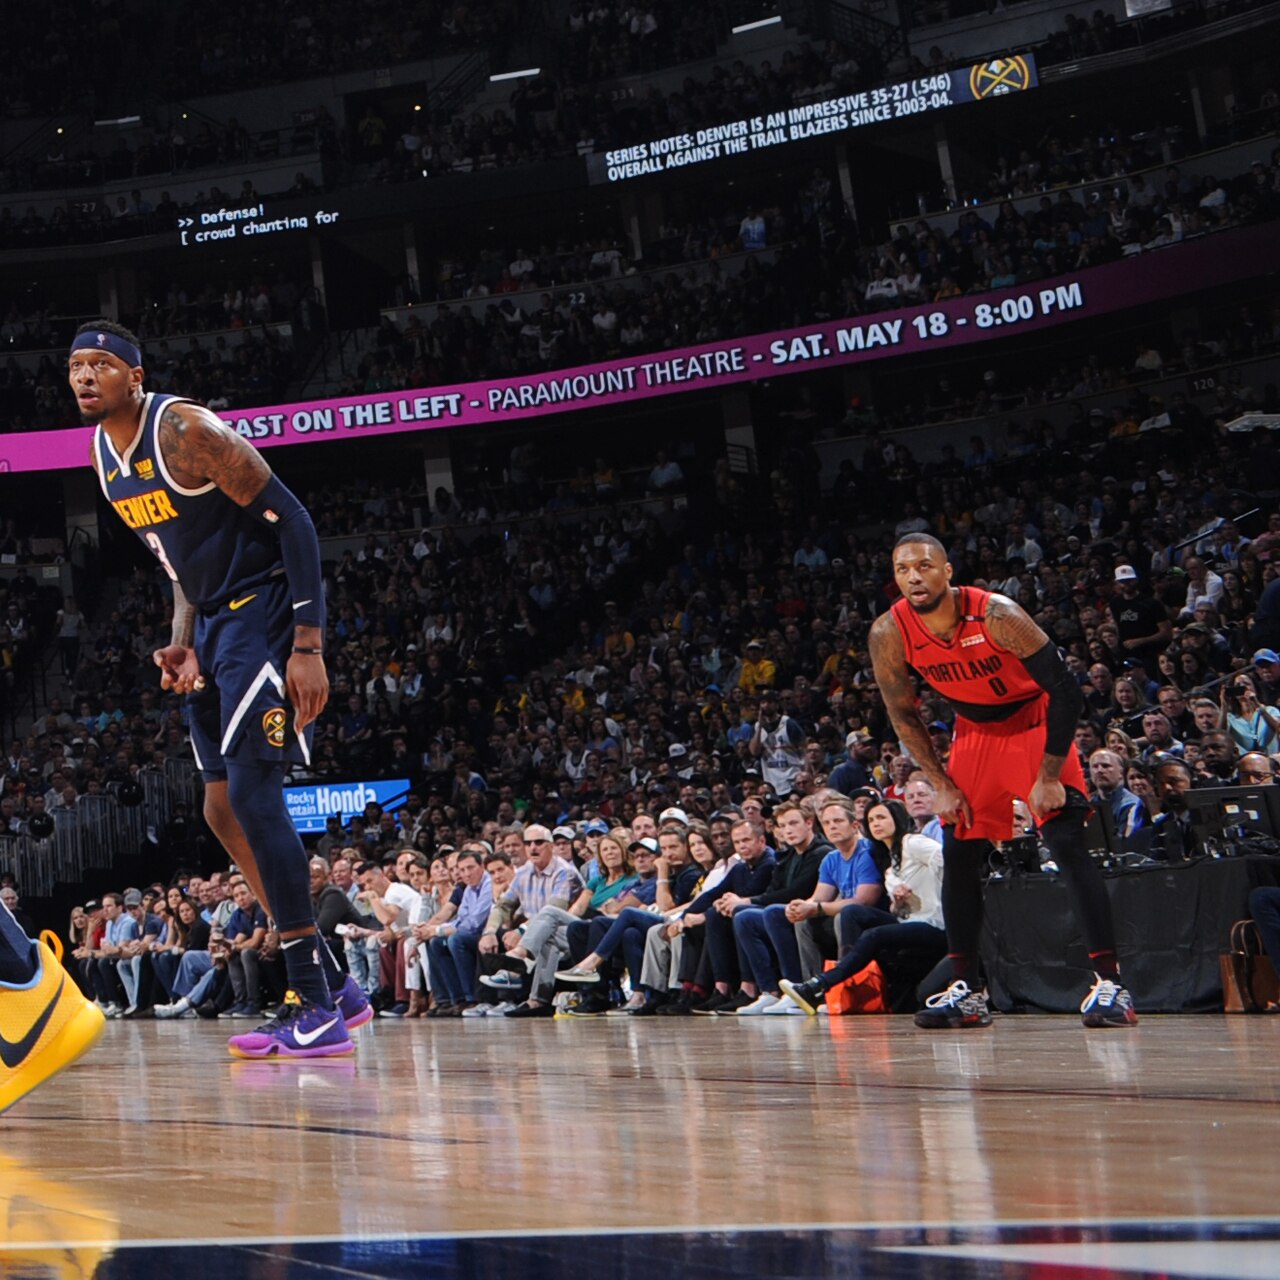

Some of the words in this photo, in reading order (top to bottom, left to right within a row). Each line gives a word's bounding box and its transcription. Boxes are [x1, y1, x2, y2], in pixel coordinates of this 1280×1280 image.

[605, 145, 648, 166] SERIES
[650, 134, 694, 157] NOTES:
[695, 123, 748, 147] DENVER
[750, 118, 764, 134] IS
[766, 112, 786, 131] AN
[788, 94, 868, 126] IMPRESSIVE
[871, 86, 909, 108] 35-27
[911, 73, 951, 98] (.546)
[608, 158, 663, 182] OVERALL
[665, 144, 720, 168] AGAINST
[724, 137, 748, 156] THE
[751, 128, 787, 150] TRAIL
[790, 115, 848, 142] BLAZERS
[851, 105, 891, 128] SINCE
[894, 92, 952, 120] 2003-04.
[194, 225, 236, 243] crowd
[242, 216, 308, 237] chanting
[315, 210, 339, 226] for
[201, 203, 264, 225] Defense!
[293, 409, 334, 433] ON
[339, 402, 391, 427] THE
[399, 393, 461, 421] LEFT
[488, 367, 638, 411] PARAMOUNT
[641, 348, 745, 387] THEATRE
[770, 333, 831, 365] SAT.
[838, 319, 903, 353] MAY
[912, 312, 948, 339] 18
[974, 295, 1034, 329] 8:00
[1040, 282, 1083, 315] PM
[918, 654, 1003, 683] PORTLAND
[988, 676, 1008, 697] 0
[287, 791, 315, 804] Rocky
[316, 783, 377, 814] Honda
